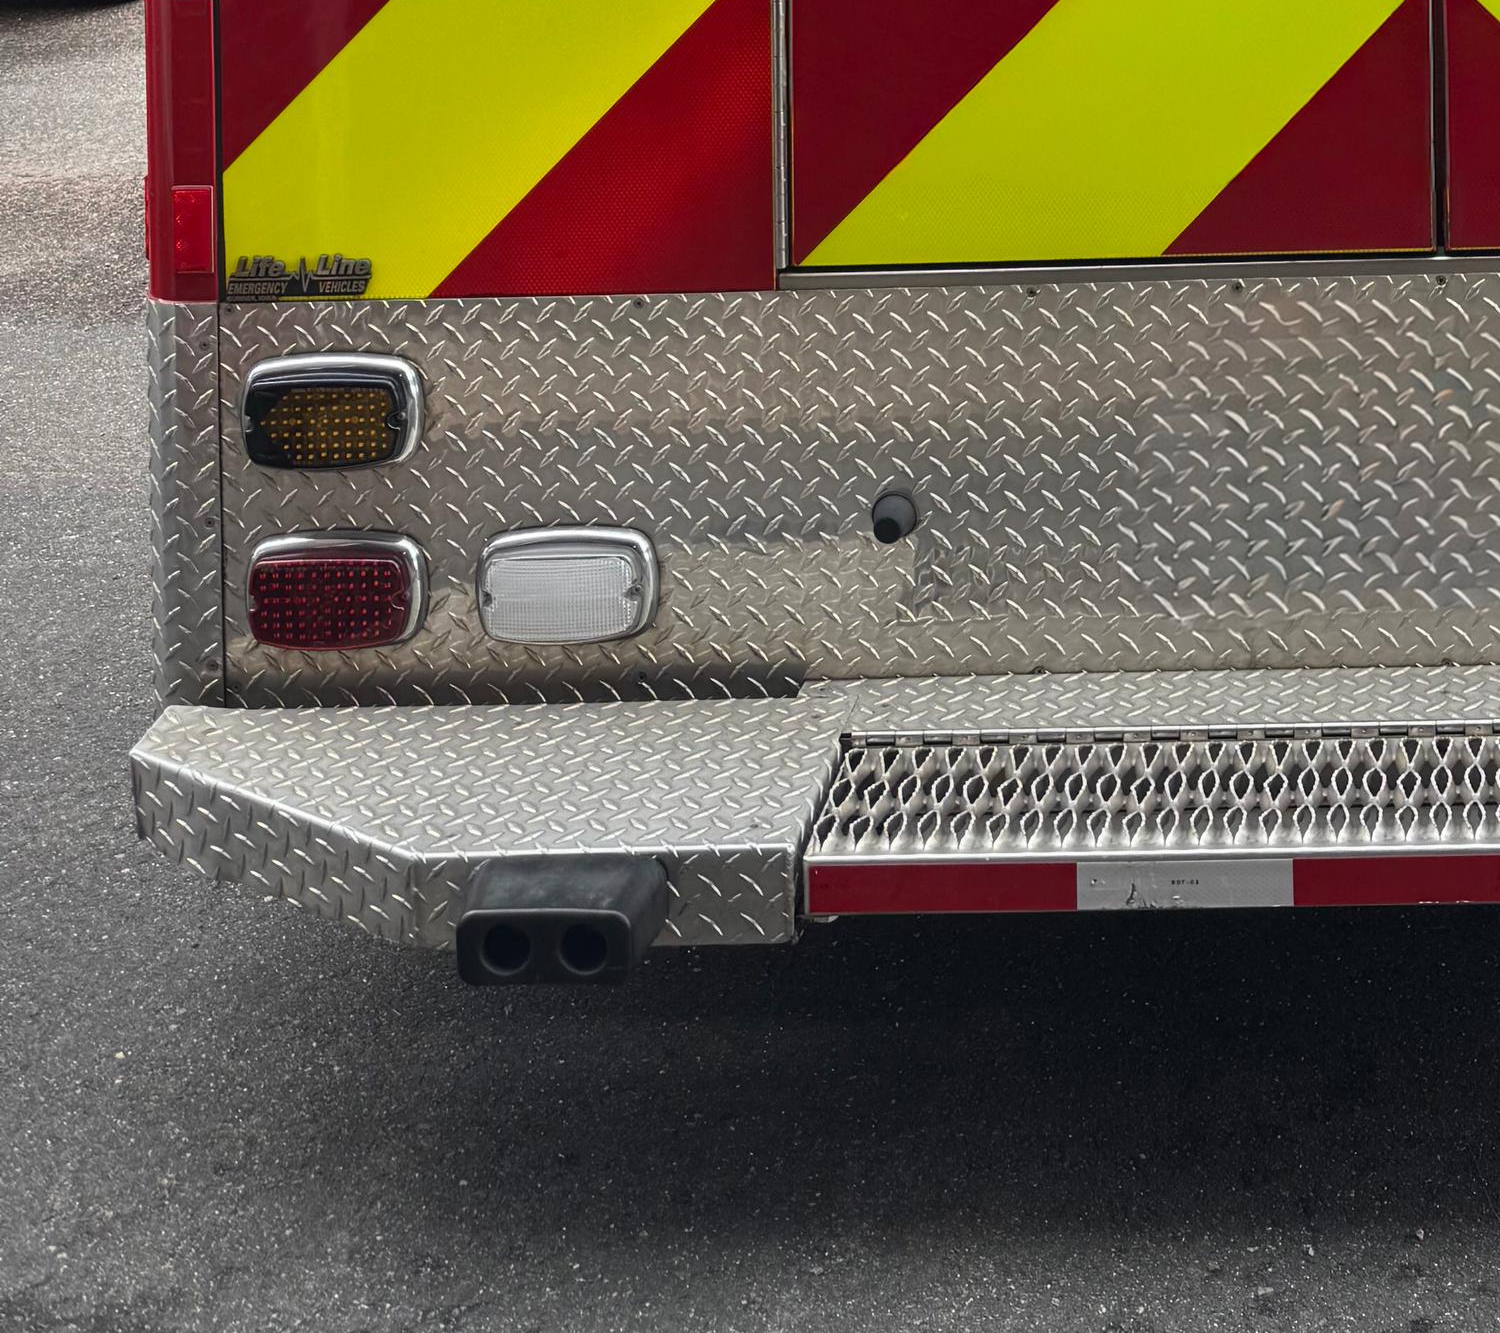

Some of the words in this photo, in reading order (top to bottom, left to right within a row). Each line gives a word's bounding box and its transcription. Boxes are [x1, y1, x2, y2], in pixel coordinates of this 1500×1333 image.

[234, 257, 285, 278] Life
[317, 254, 371, 276] Line
[228, 281, 288, 295] EMERGENCY
[319, 280, 366, 293] VEHICLES
